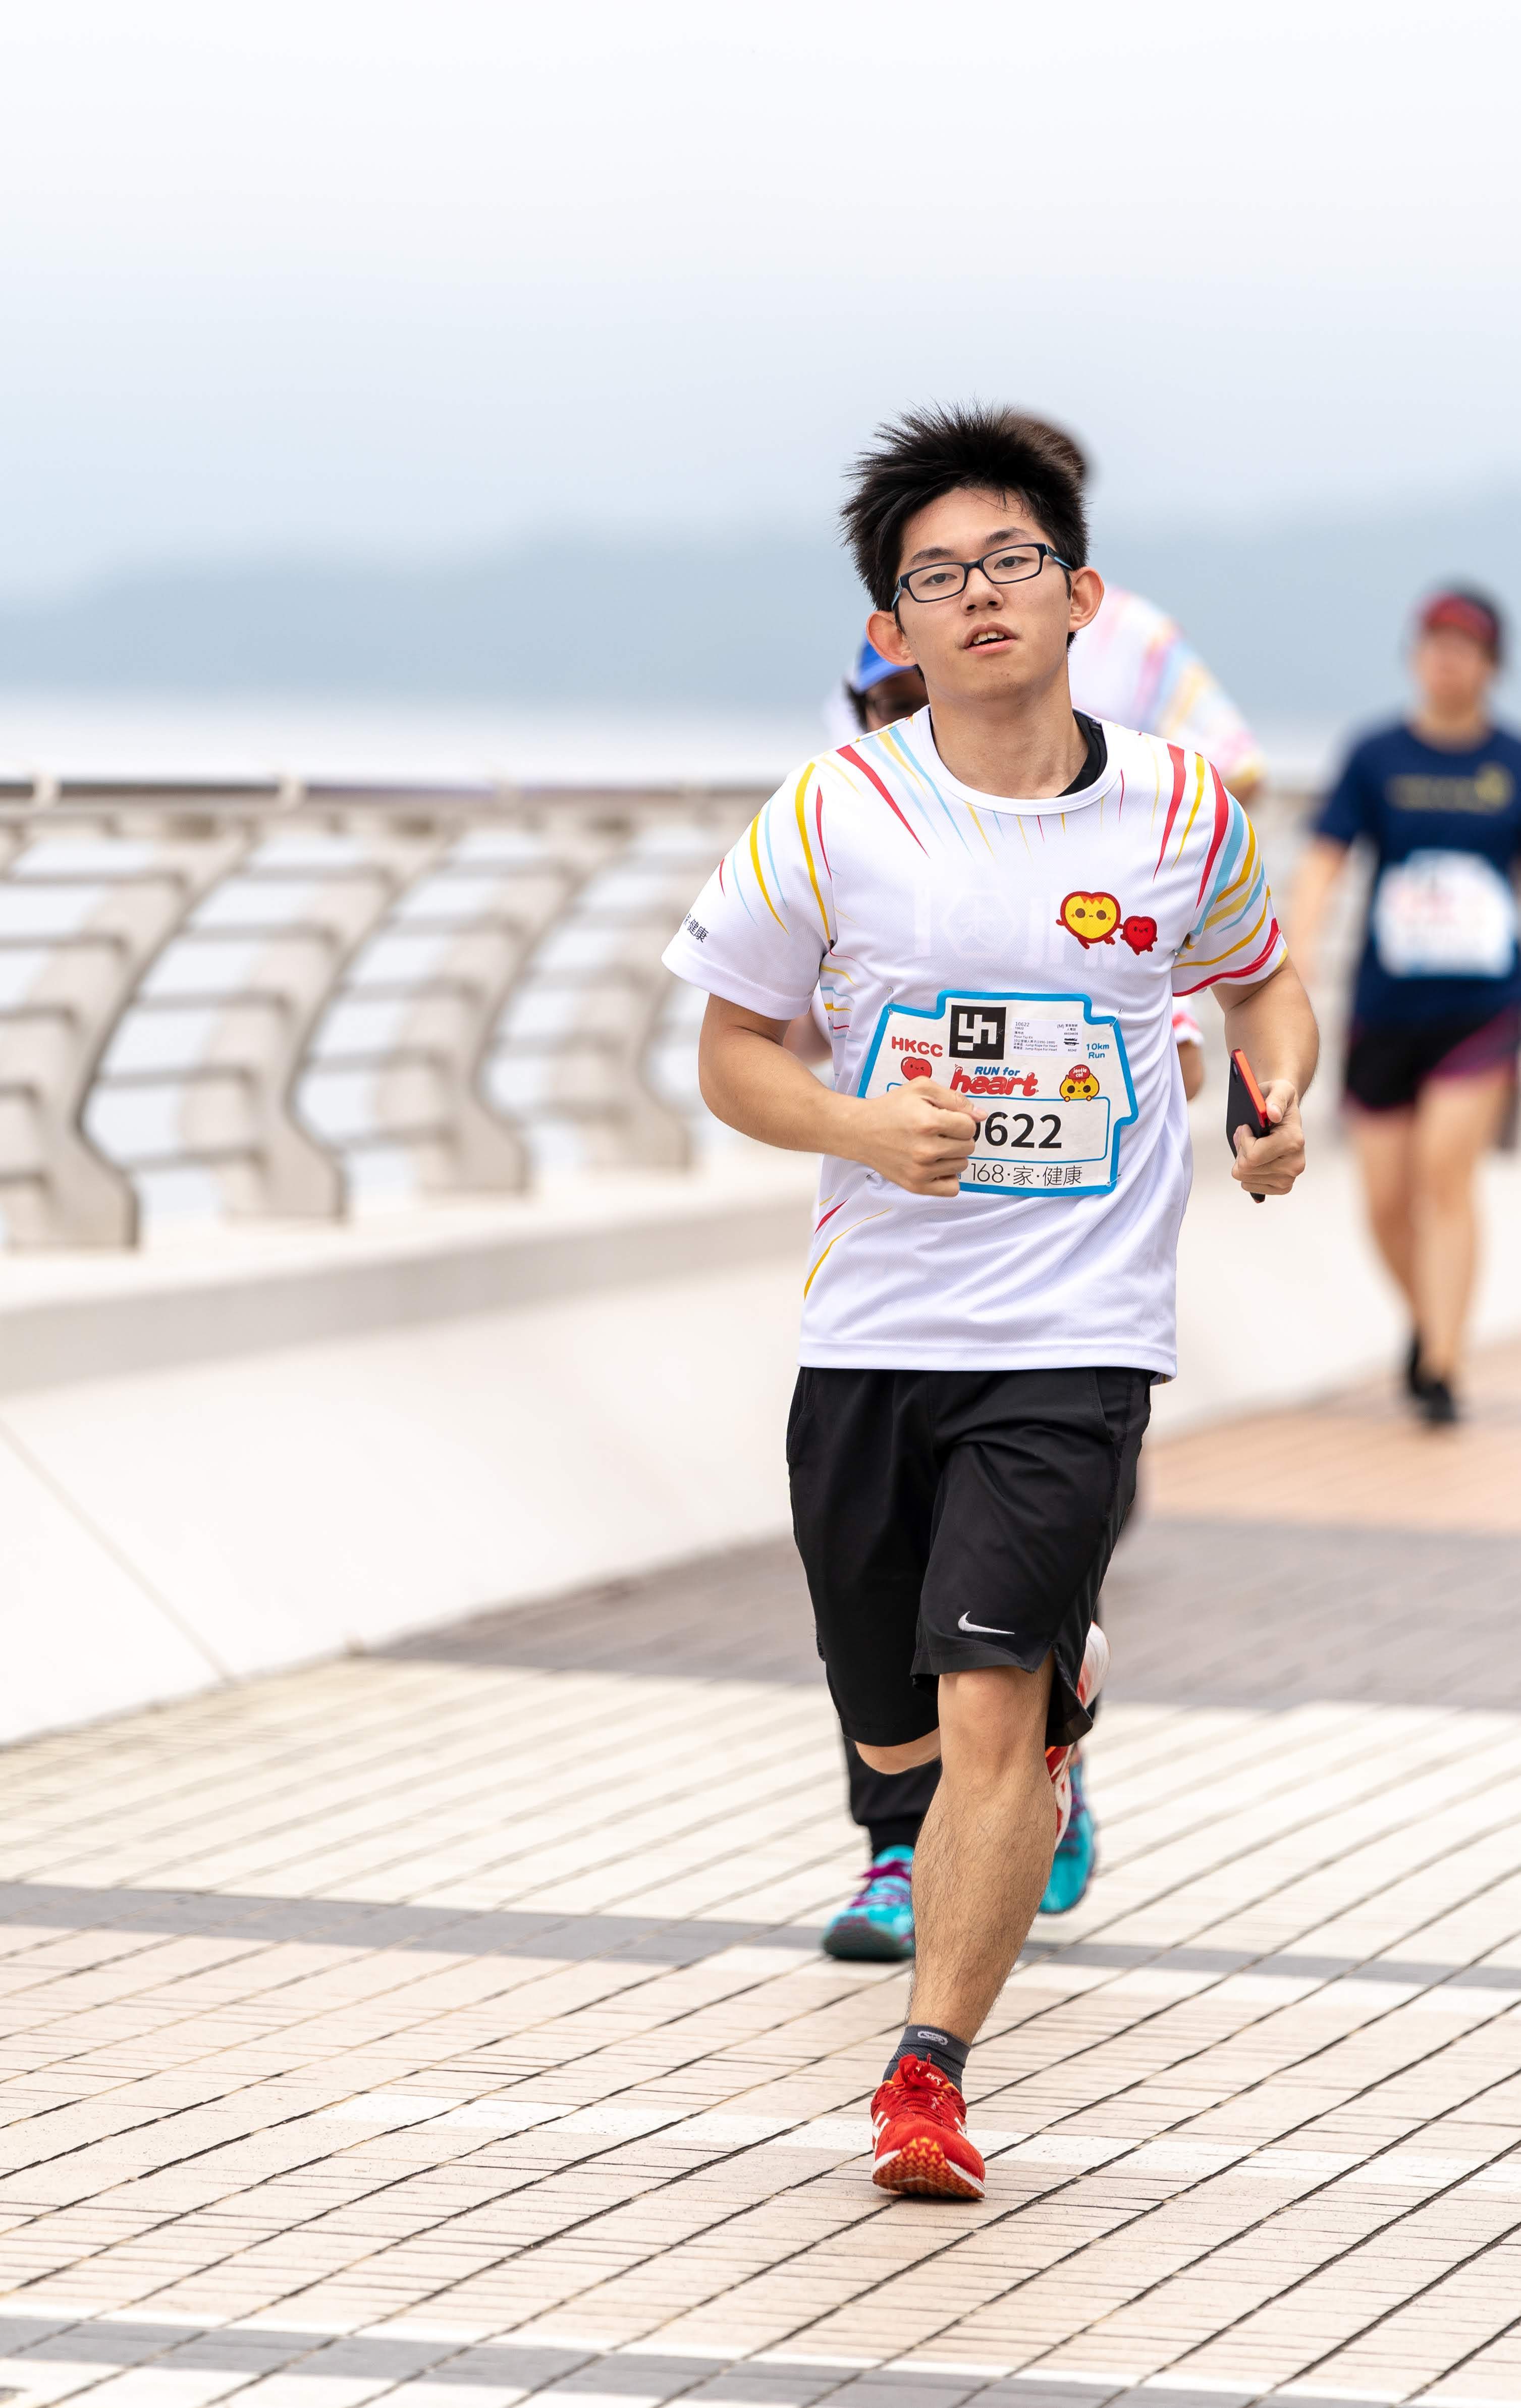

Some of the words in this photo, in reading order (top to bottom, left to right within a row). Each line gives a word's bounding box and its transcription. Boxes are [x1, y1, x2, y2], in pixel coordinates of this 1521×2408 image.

[892, 1036, 943, 1057] HKCC
[1086, 1043, 1110, 1051] 10km
[974, 1066, 1000, 1076] RUN
[1003, 1067, 1020, 1076] for
[950, 1066, 1038, 1097] heart
